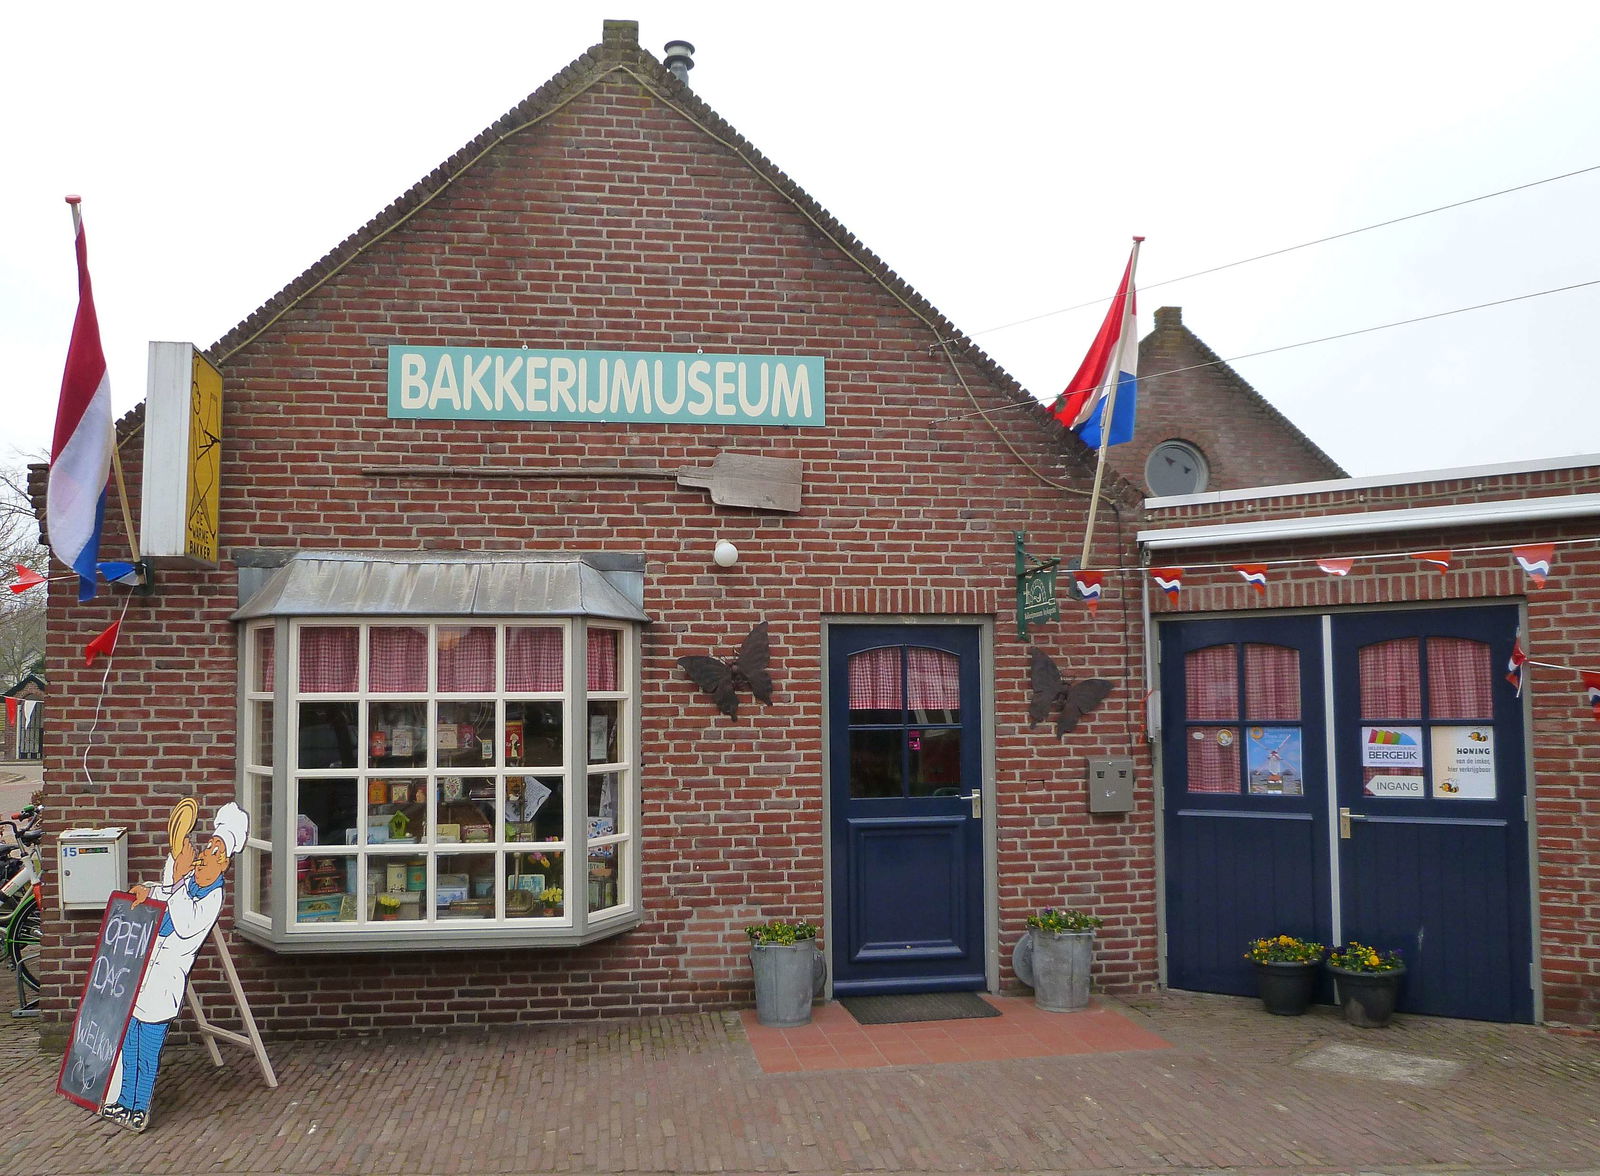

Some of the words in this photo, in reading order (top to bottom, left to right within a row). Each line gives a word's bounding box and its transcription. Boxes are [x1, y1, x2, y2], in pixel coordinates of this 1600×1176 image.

[401, 353, 812, 418] BAKKERIJMUSEUM
[196, 510, 204, 526] DE
[191, 525, 209, 544] WARME
[189, 540, 211, 560] BAKKER
[1368, 751, 1418, 760] BERGEIJK
[1456, 747, 1490, 755] HONING
[1376, 782, 1418, 791] INGANG
[62, 847, 77, 857] 15
[104, 914, 154, 959] OPEN
[93, 955, 131, 998] DAG
[76, 1016, 118, 1066] WELKOM
